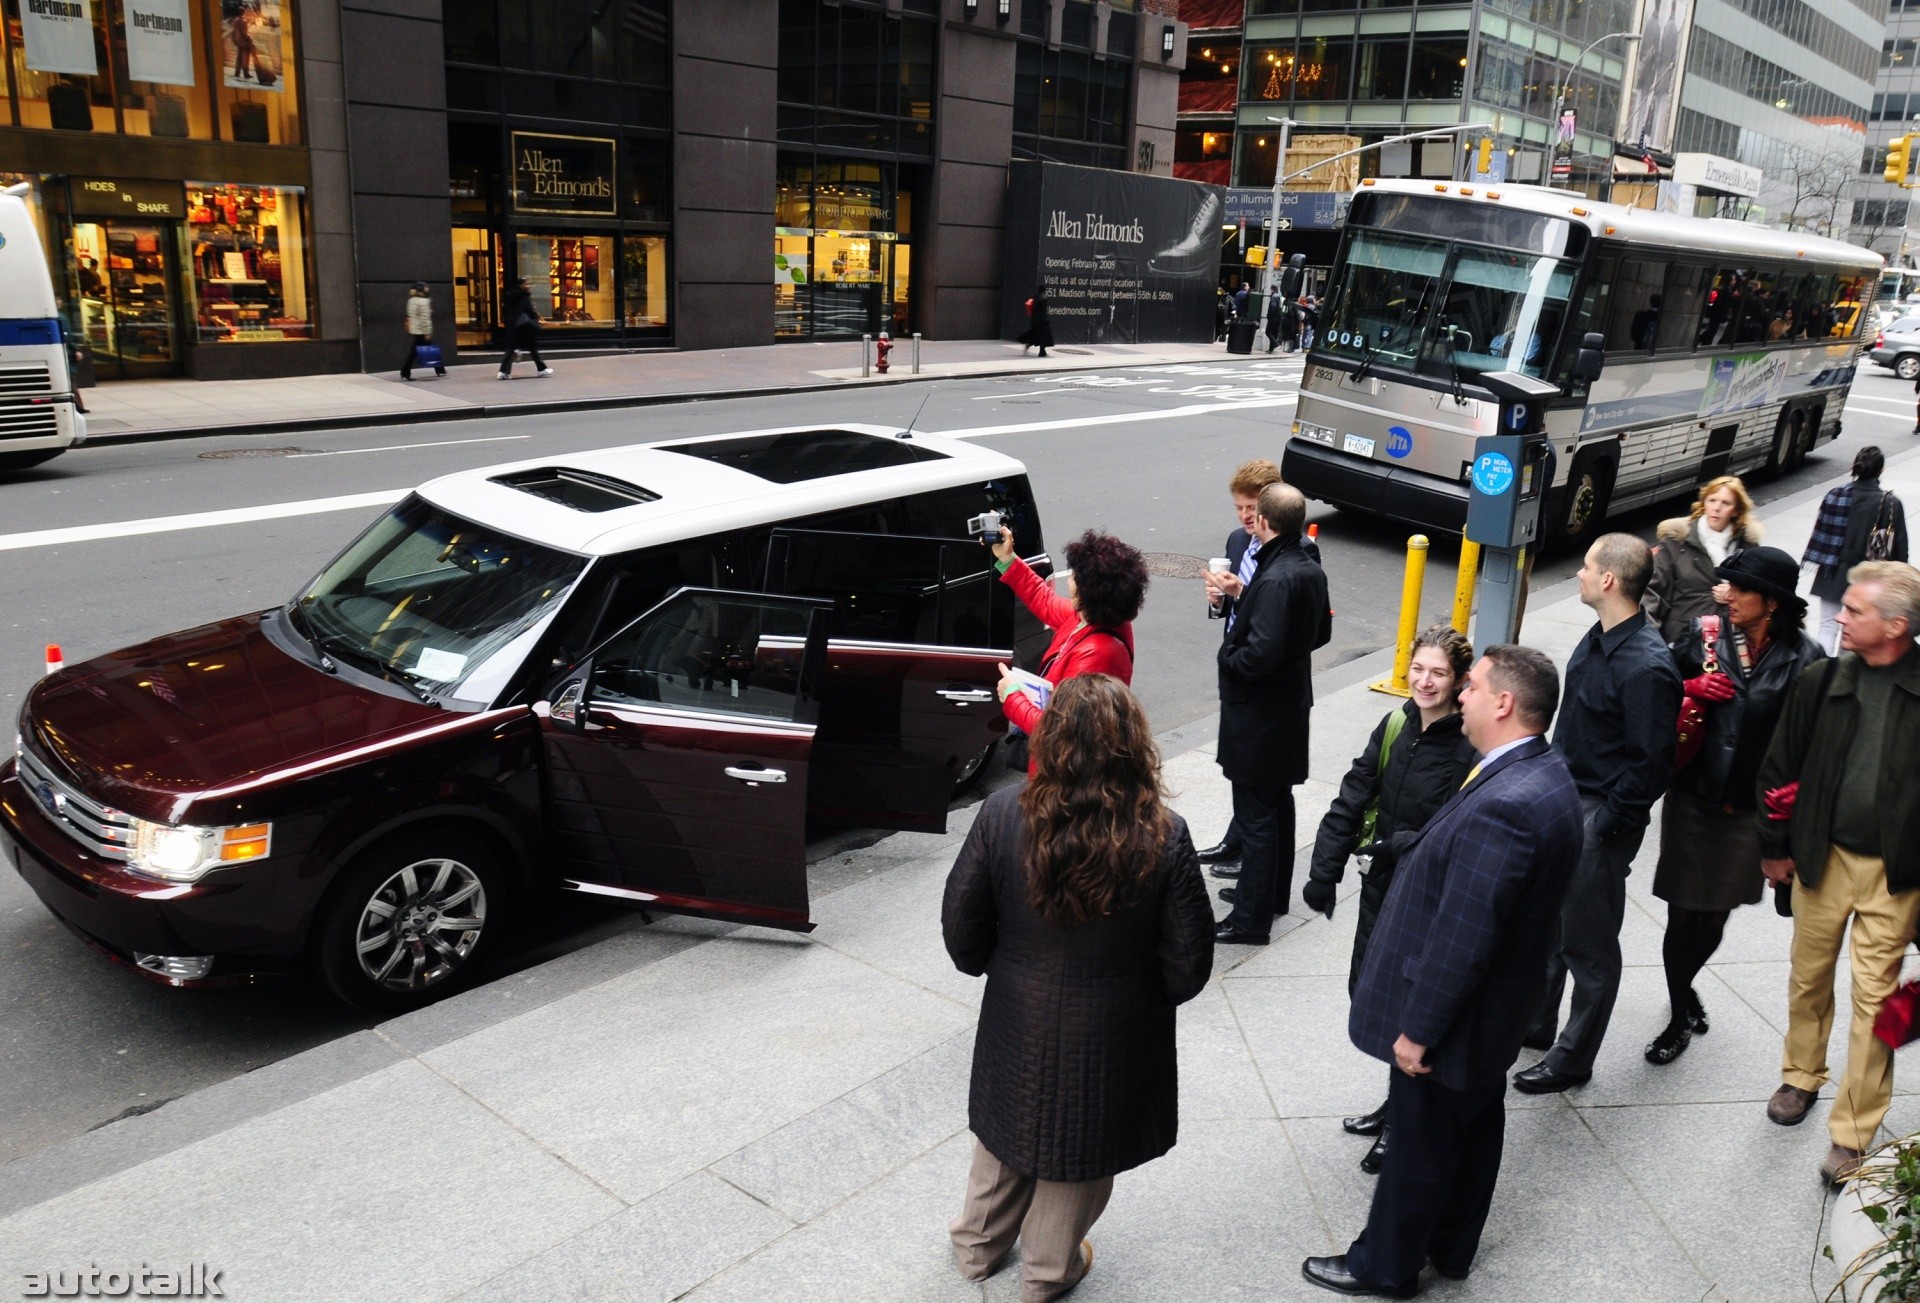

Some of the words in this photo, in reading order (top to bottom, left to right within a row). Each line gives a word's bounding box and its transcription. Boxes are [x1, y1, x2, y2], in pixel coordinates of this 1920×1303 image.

[133, 10, 183, 33] hartmann
[519, 149, 563, 173] Allen
[84, 182, 116, 192] HIDES
[533, 172, 611, 198] Edmonds
[122, 193, 132, 202] in
[1241, 193, 1299, 205] illuminted
[137, 202, 170, 213] SHAPE
[818, 205, 859, 218] ROBERT
[864, 209, 892, 220] MARC
[1046, 209, 1082, 239] Allen
[1085, 213, 1144, 243] Edmonds
[1045, 257, 1070, 270] Opening
[1071, 258, 1098, 271] February
[1100, 260, 1116, 270] 2009
[1044, 275, 1059, 286] Visit
[1060, 277, 1068, 285] us
[1069, 277, 1077, 286] at
[1078, 277, 1089, 286] our
[1089, 278, 1112, 288] current
[1113, 279, 1136, 288] location
[1136, 280, 1143, 288] at
[1059, 289, 1086, 298] Madison
[1087, 289, 1109, 299] Avenue
[1151, 291, 1157, 300] &
[1327, 329, 1364, 348] 008
[1314, 368, 1334, 381] 2923
[1511, 403, 1527, 429] P
[1386, 432, 1408, 452] MTA
[1481, 457, 1491, 471] P
[1493, 458, 1508, 467] MUNI
[1492, 466, 1512, 475] METER
[1486, 472, 1499, 480] PAY
